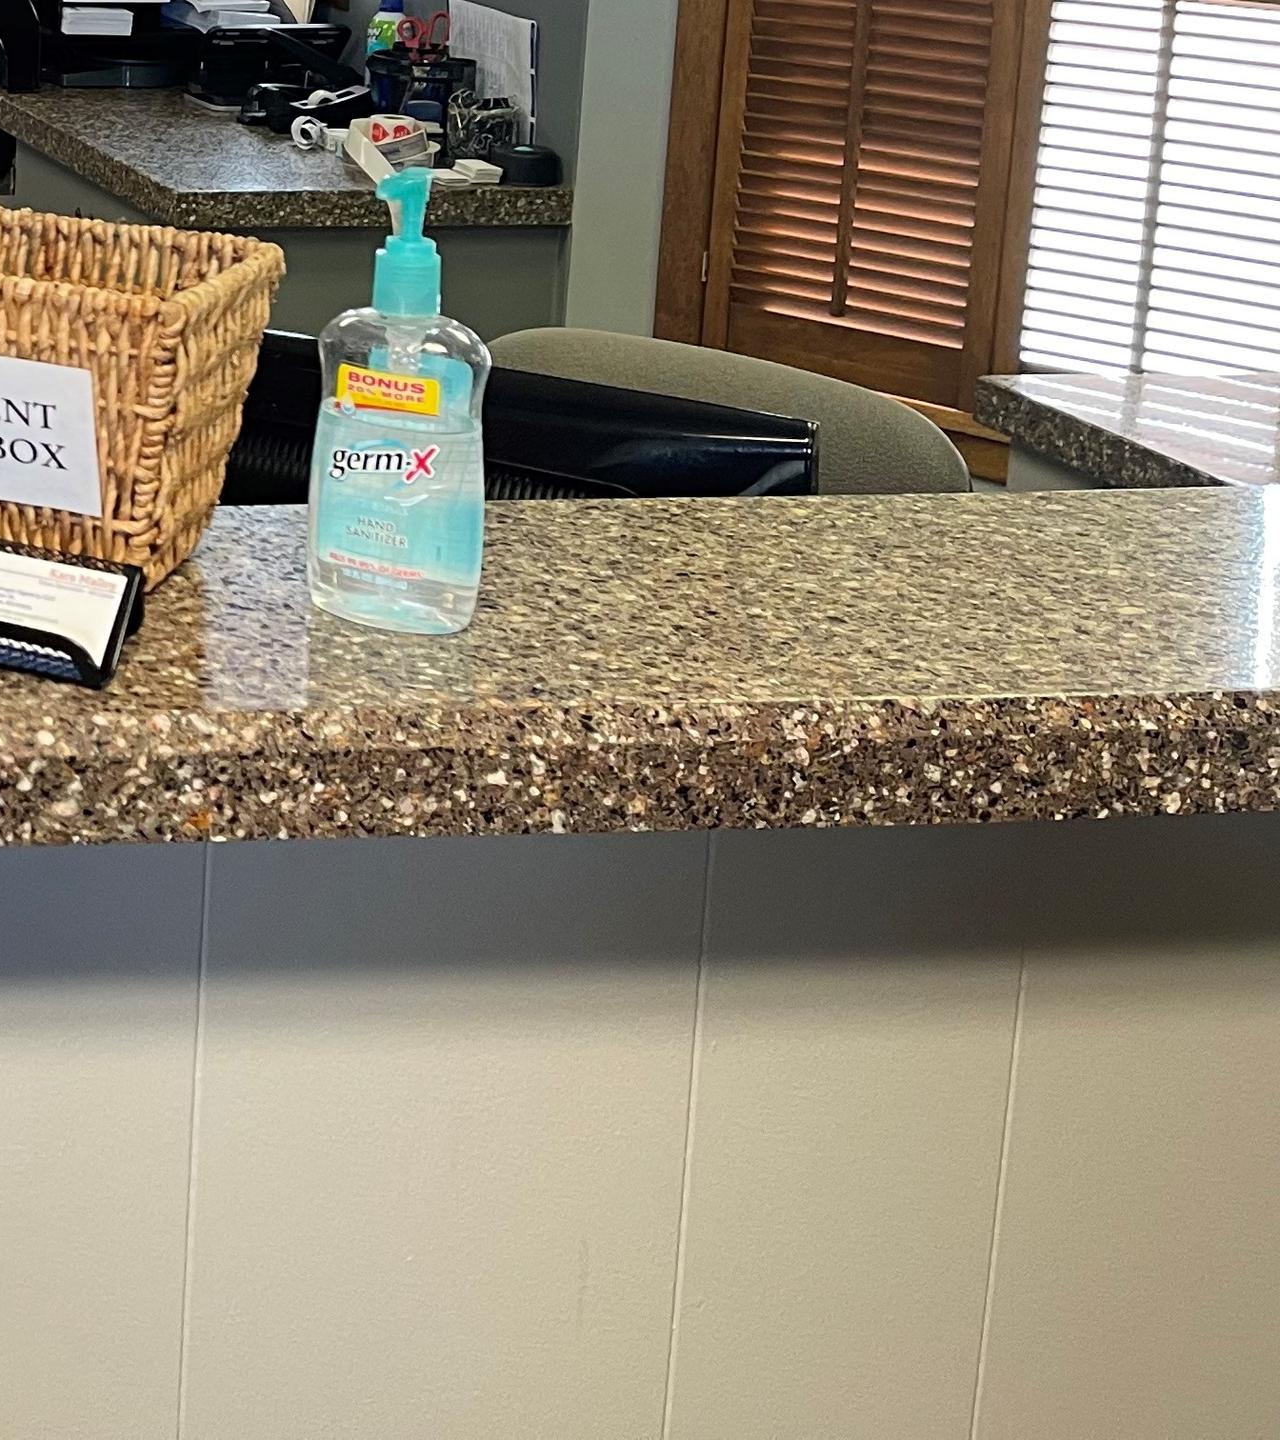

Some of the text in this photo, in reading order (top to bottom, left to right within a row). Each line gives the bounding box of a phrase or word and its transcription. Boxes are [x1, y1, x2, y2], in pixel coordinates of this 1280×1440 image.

[348, 371, 425, 394] BONUS
[382, 391, 425, 403] MORE
[357, 516, 395, 532] HAND
[345, 526, 409, 548] SANITIZER
